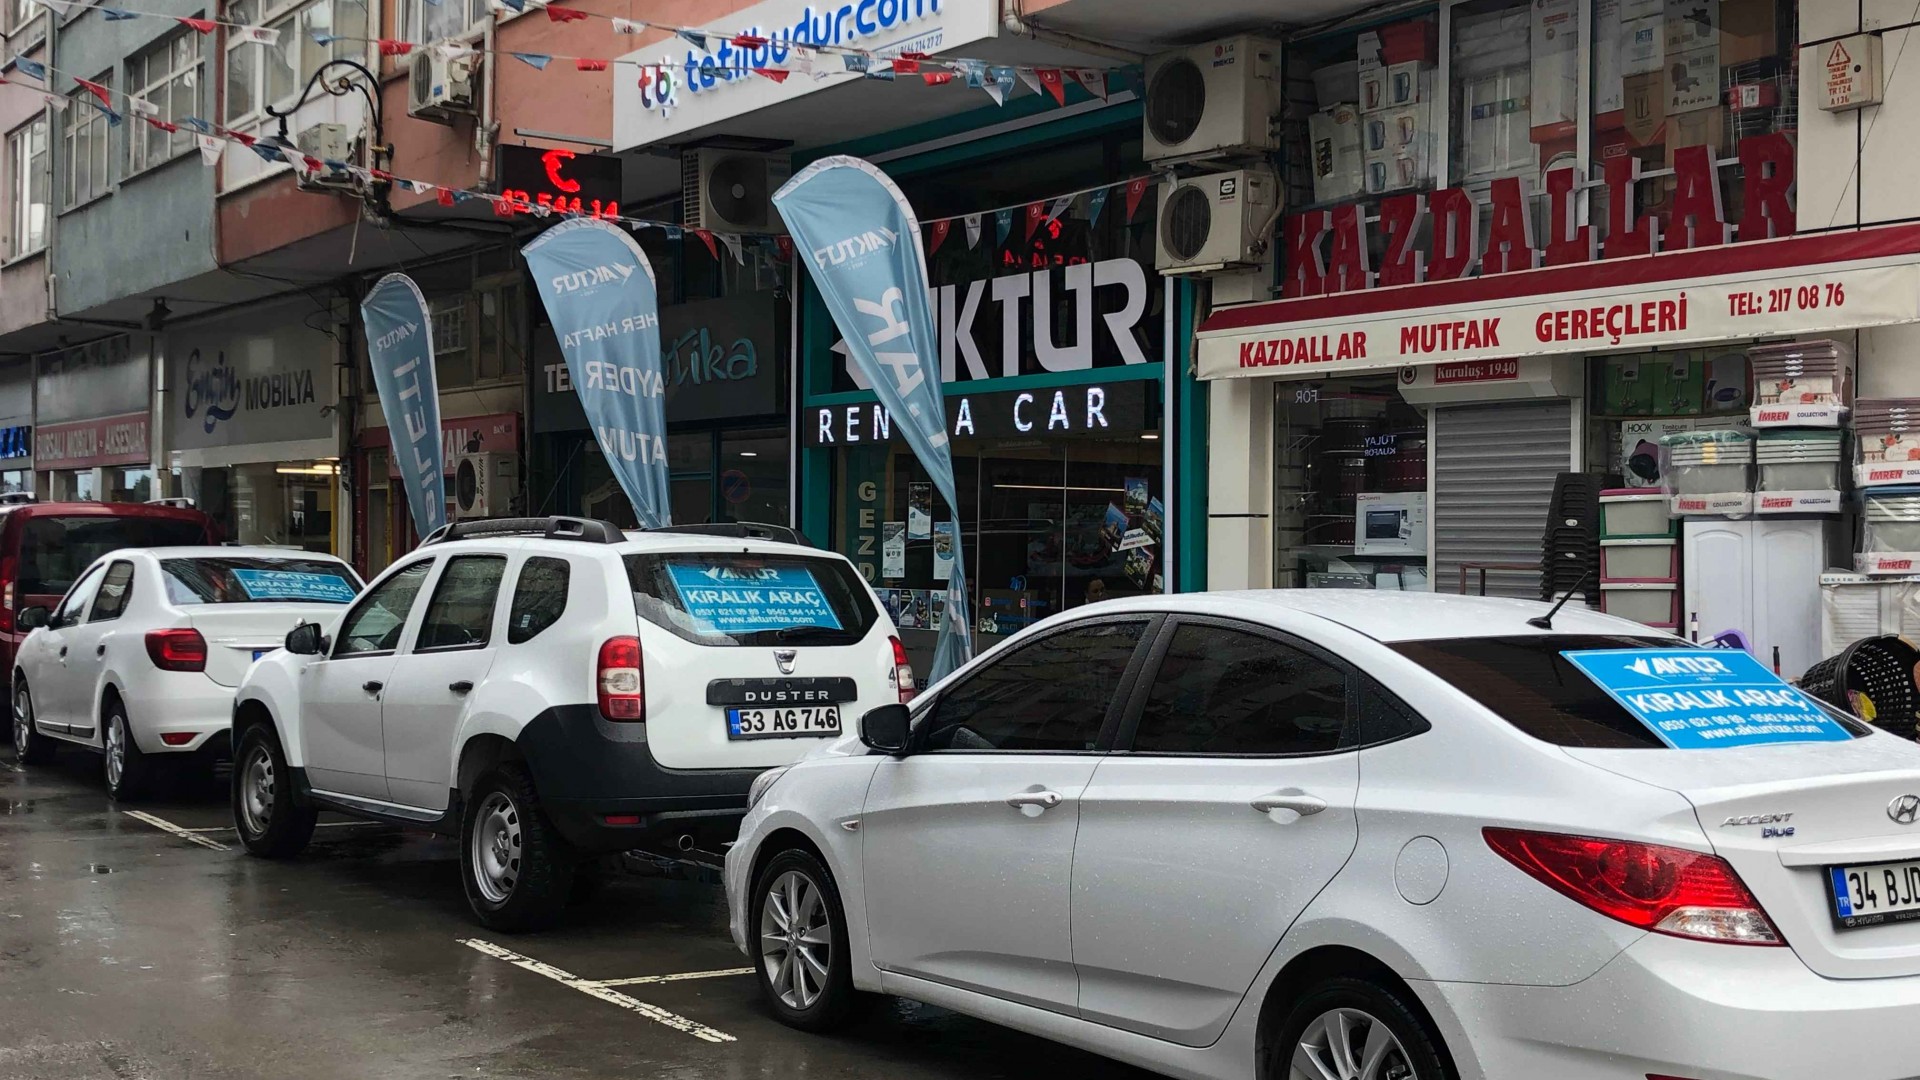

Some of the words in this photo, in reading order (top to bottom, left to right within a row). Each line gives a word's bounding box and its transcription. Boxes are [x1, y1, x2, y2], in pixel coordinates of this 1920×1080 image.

[1283, 131, 1798, 298] KAZDALLAR
[1239, 331, 1367, 368] KAZDALLAR
[1400, 318, 1501, 355] MUTFAK
[1535, 291, 1687, 345] GEREÇLERİ
[1728, 291, 1763, 316] TEL:
[1768, 287, 1792, 313] 217
[1797, 285, 1819, 310] 08
[1826, 282, 1845, 307] 76
[1437, 365, 1484, 381] Kuruluş:
[1488, 360, 1517, 376] 1940
[245, 364, 315, 410] MOBİLYA
[955, 398, 975, 435] A
[1013, 387, 1109, 432] CAR
[1758, 410, 1789, 422] İMREN
[1627, 423, 1652, 433] HOOK
[1869, 469, 1903, 481] İMREN
[1877, 558, 1912, 570] İMREN
[769, 590, 820, 607] ARAÇ
[1650, 657, 1732, 674] AKTUR
[745, 690, 829, 701] DUSTER
[1733, 687, 1809, 712] ARAÇ
[740, 712, 765, 732] 53
[773, 710, 798, 731] AG
[801, 708, 837, 730] 746
[1720, 812, 1794, 828] ACCENT
[1761, 826, 1796, 839] blue
[1838, 896, 1850, 908] TR
[1849, 871, 1877, 910] 34
